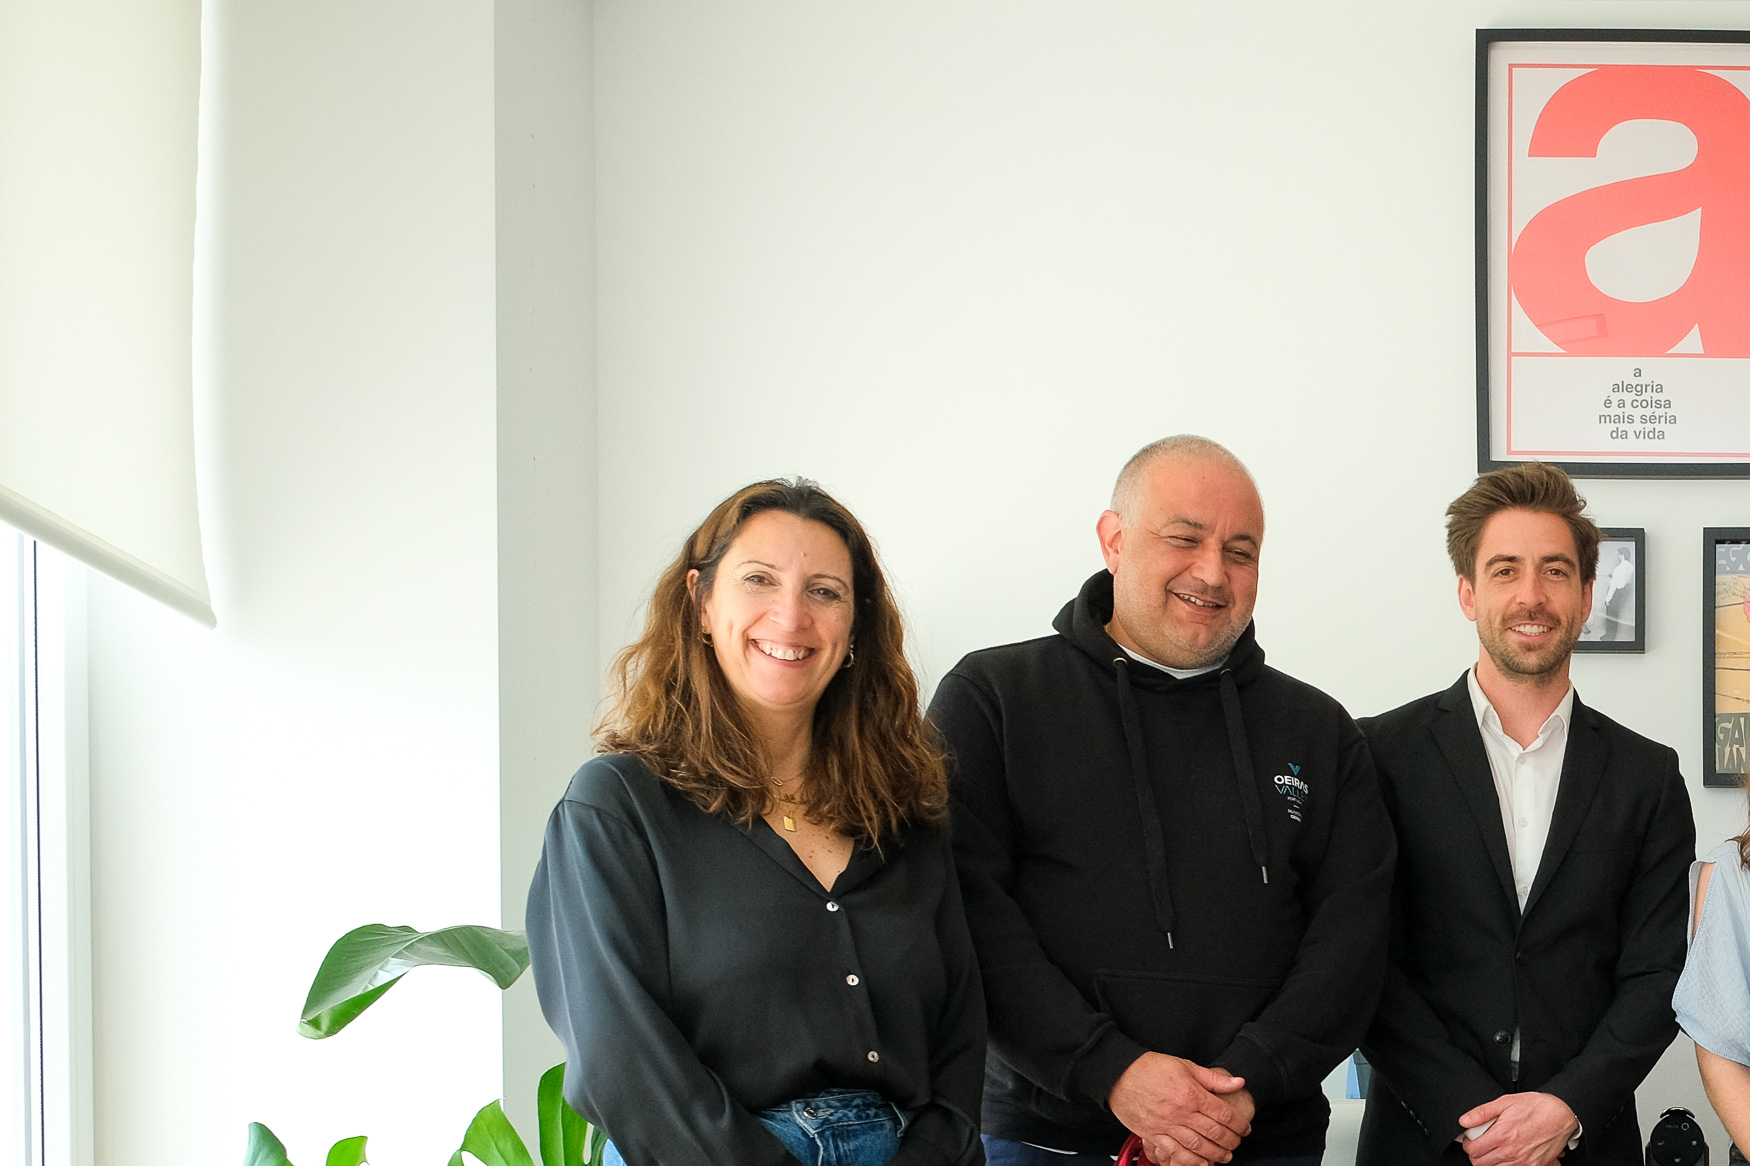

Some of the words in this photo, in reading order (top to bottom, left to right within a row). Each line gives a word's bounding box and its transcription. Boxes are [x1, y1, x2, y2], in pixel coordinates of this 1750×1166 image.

[1633, 367, 1642, 378] a
[1611, 380, 1664, 396] alegria
[1603, 395, 1613, 409] é
[1617, 398, 1626, 409] a
[1630, 396, 1672, 409] coisa
[1598, 411, 1635, 424] mais
[1639, 411, 1677, 424] séria
[1610, 427, 1628, 440] da
[1633, 427, 1665, 440] vida
[1273, 774, 1309, 795] OEIRAS
